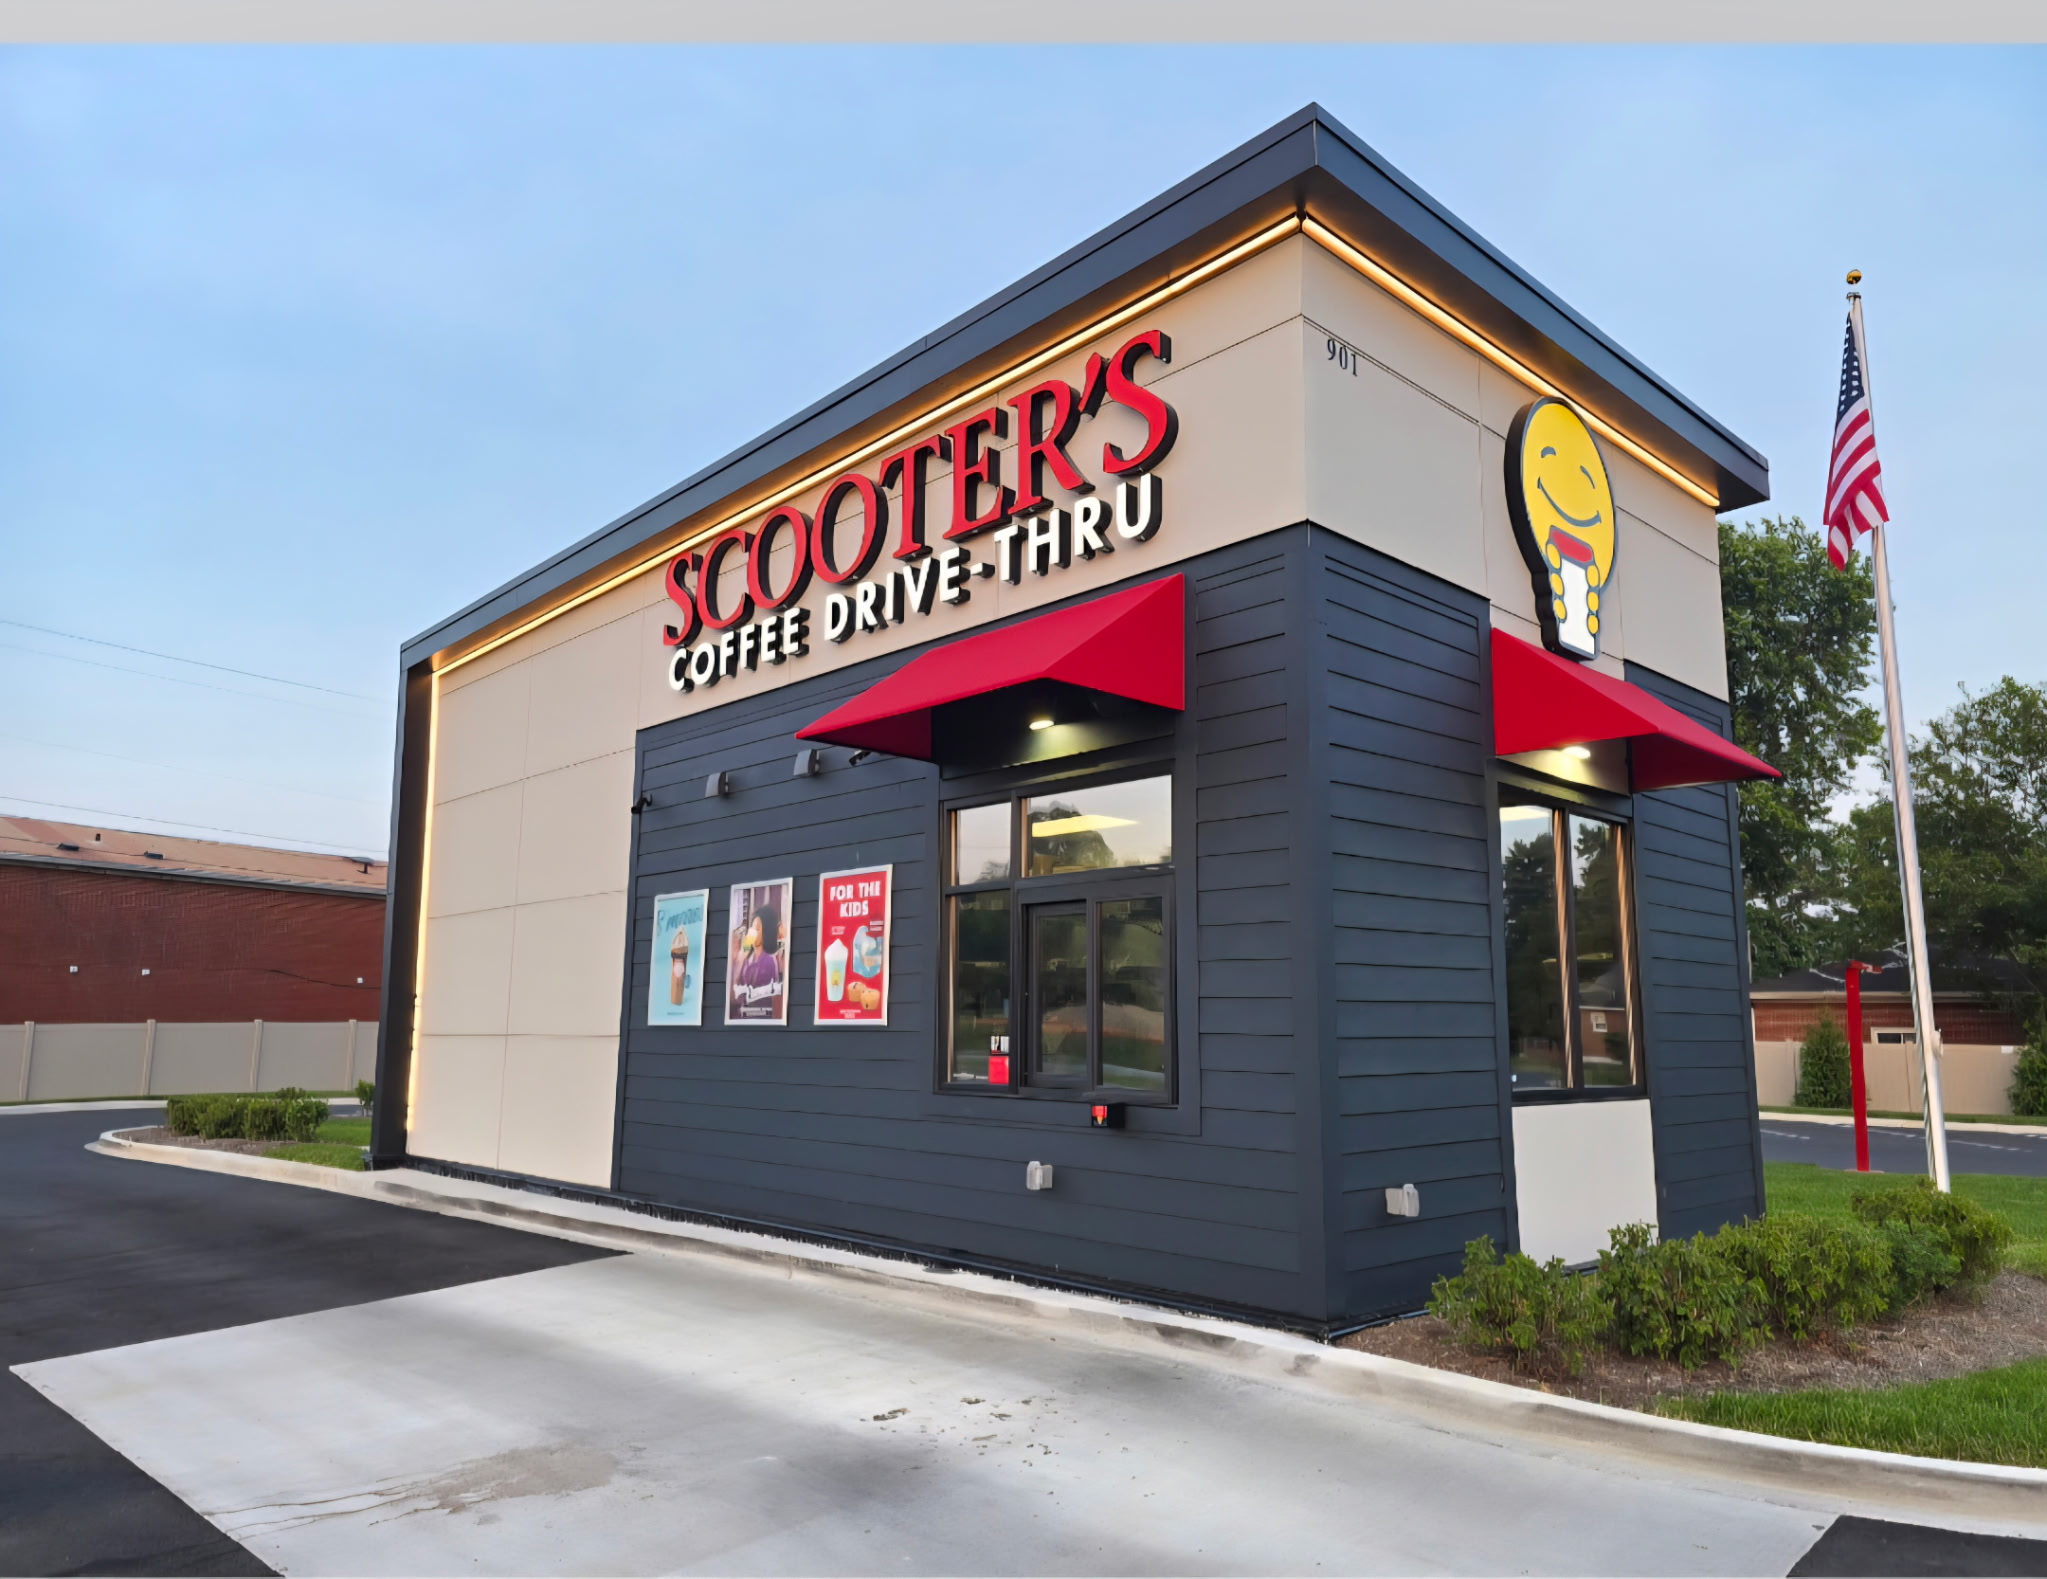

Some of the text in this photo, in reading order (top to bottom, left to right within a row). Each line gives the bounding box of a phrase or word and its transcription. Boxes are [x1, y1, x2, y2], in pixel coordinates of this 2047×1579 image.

[1327, 338, 1358, 377] 901
[663, 330, 1174, 646] SCOOTER'S
[669, 473, 1157, 691] COFFEE DRIVE-THRU
[829, 880, 881, 901] FOR THE
[840, 900, 869, 917] KIDS
